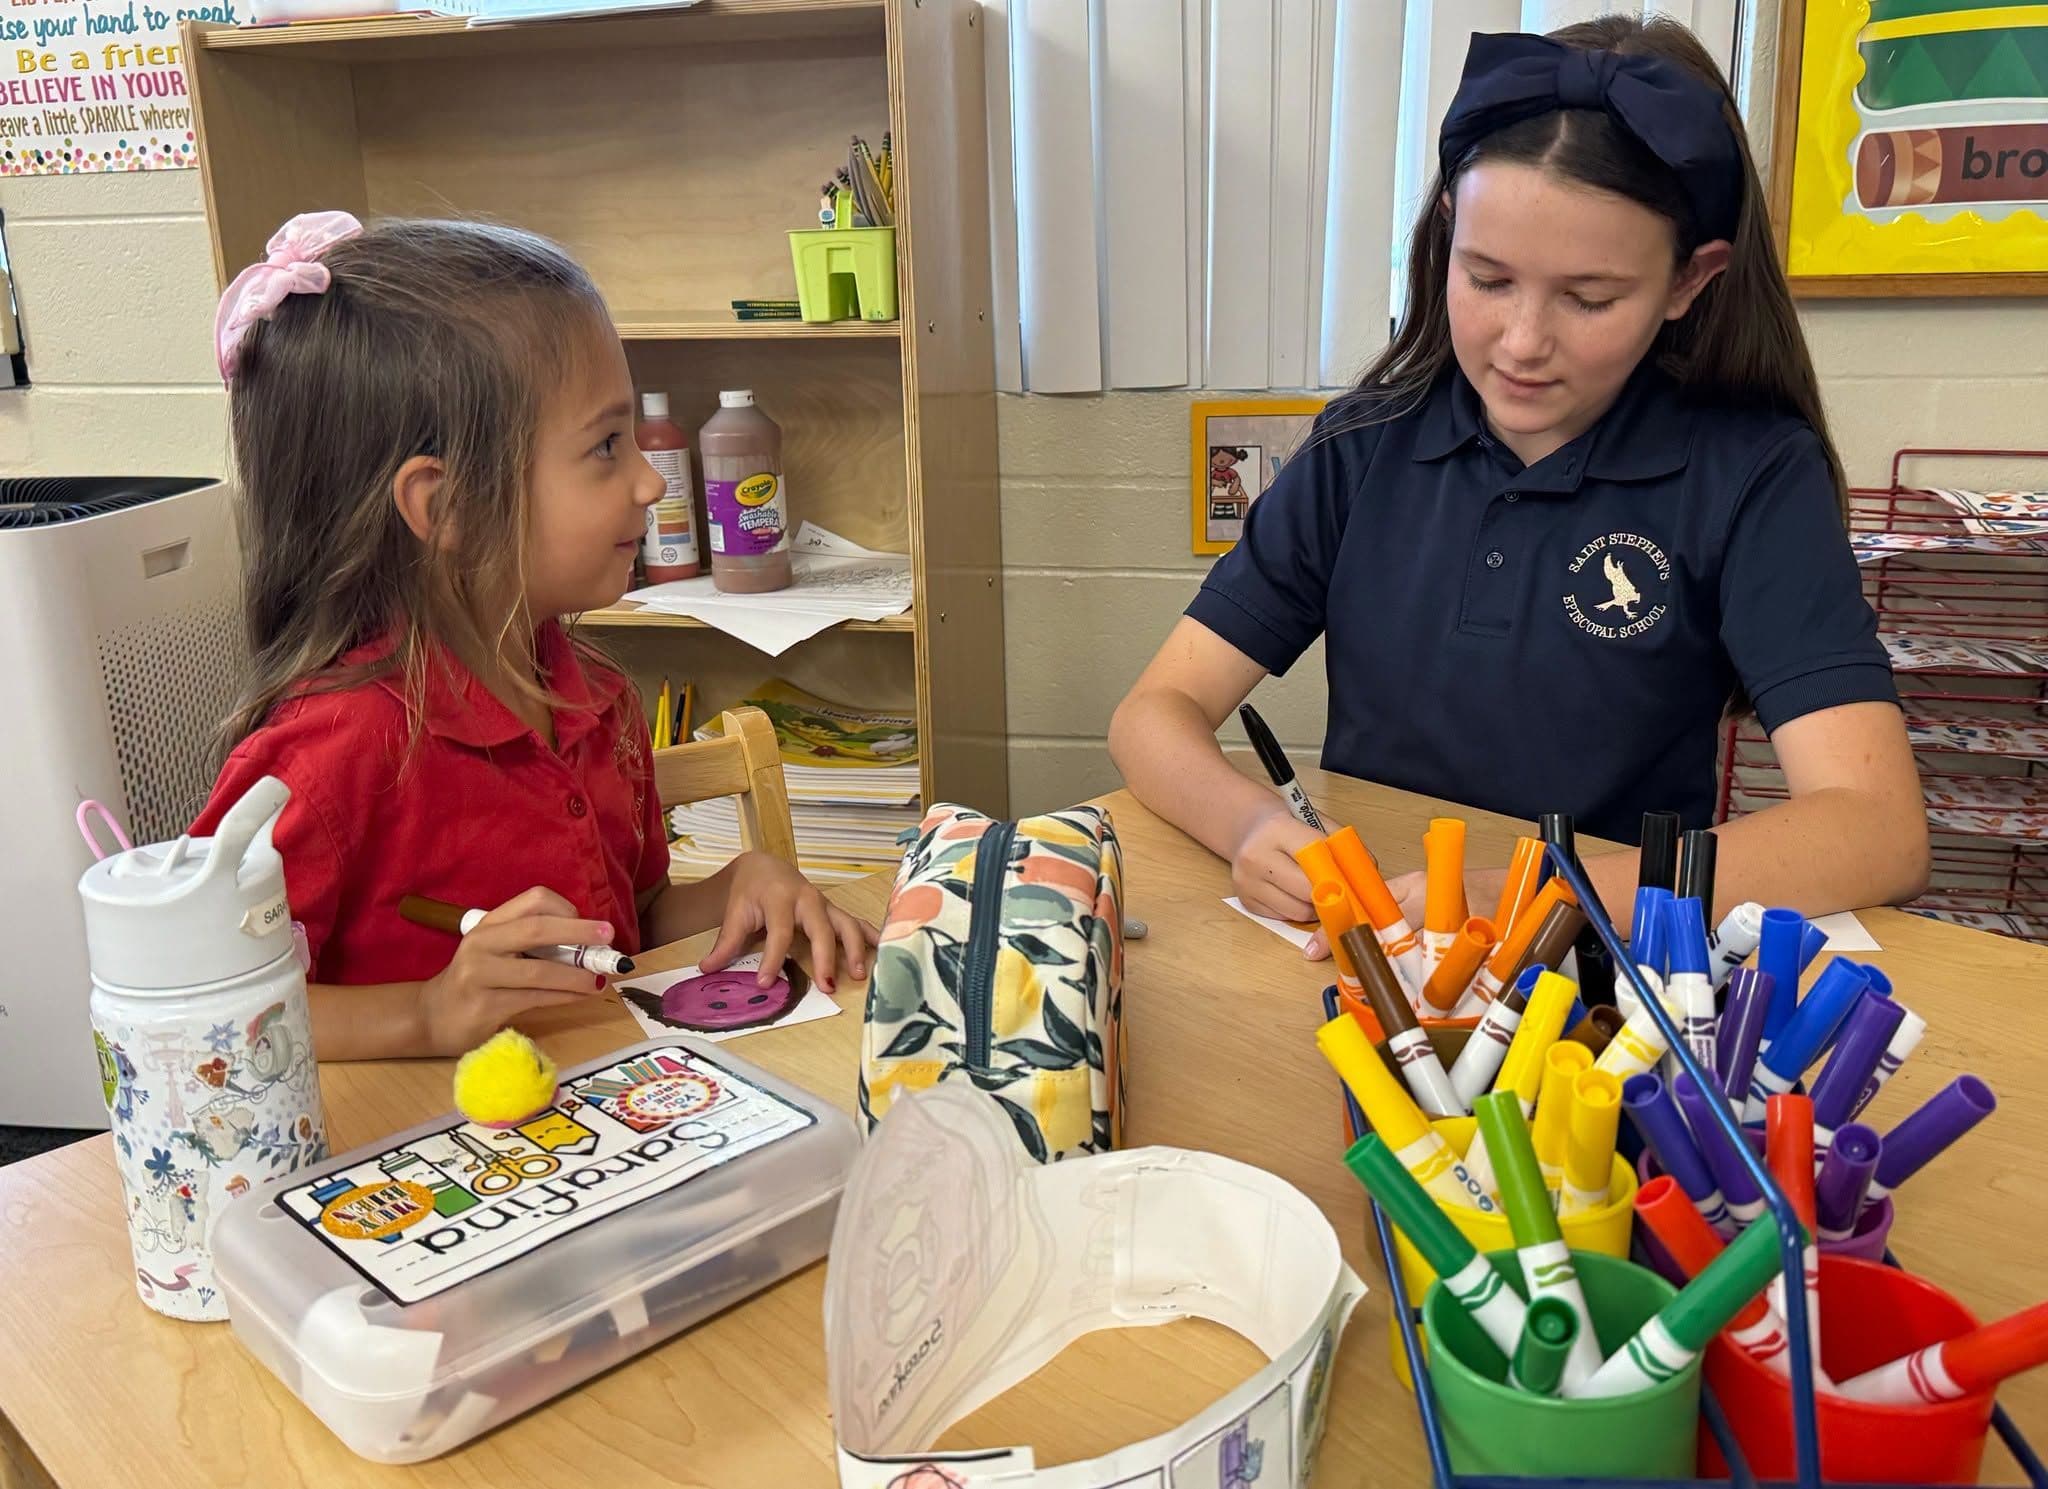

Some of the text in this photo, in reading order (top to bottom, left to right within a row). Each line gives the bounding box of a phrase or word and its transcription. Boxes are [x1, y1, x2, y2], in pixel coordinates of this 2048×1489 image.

[33, 16, 77, 47] your
[83, 3, 139, 34] hand
[143, 5, 170, 31] to
[16, 49, 58, 73] Be
[70, 51, 90, 70] a
[0, 70, 187, 106] BELIEVE IN YOUR
[32, 115, 42, 136] a
[42, 108, 79, 136] little
[79, 104, 139, 134] SPARKLE
[140, 103, 191, 130] wherev
[742, 479, 773, 493] Crayola
[742, 517, 779, 531] TEMPERA
[1568, 535, 1606, 573] SAINT
[1562, 594, 1667, 639] EPISCOPAL SCHOOL
[632, 1081, 681, 1107] BRAVE!
[654, 1090, 681, 1105] ARE
[664, 1094, 697, 1110] YOU
[415, 1121, 730, 1255] Sarafina
